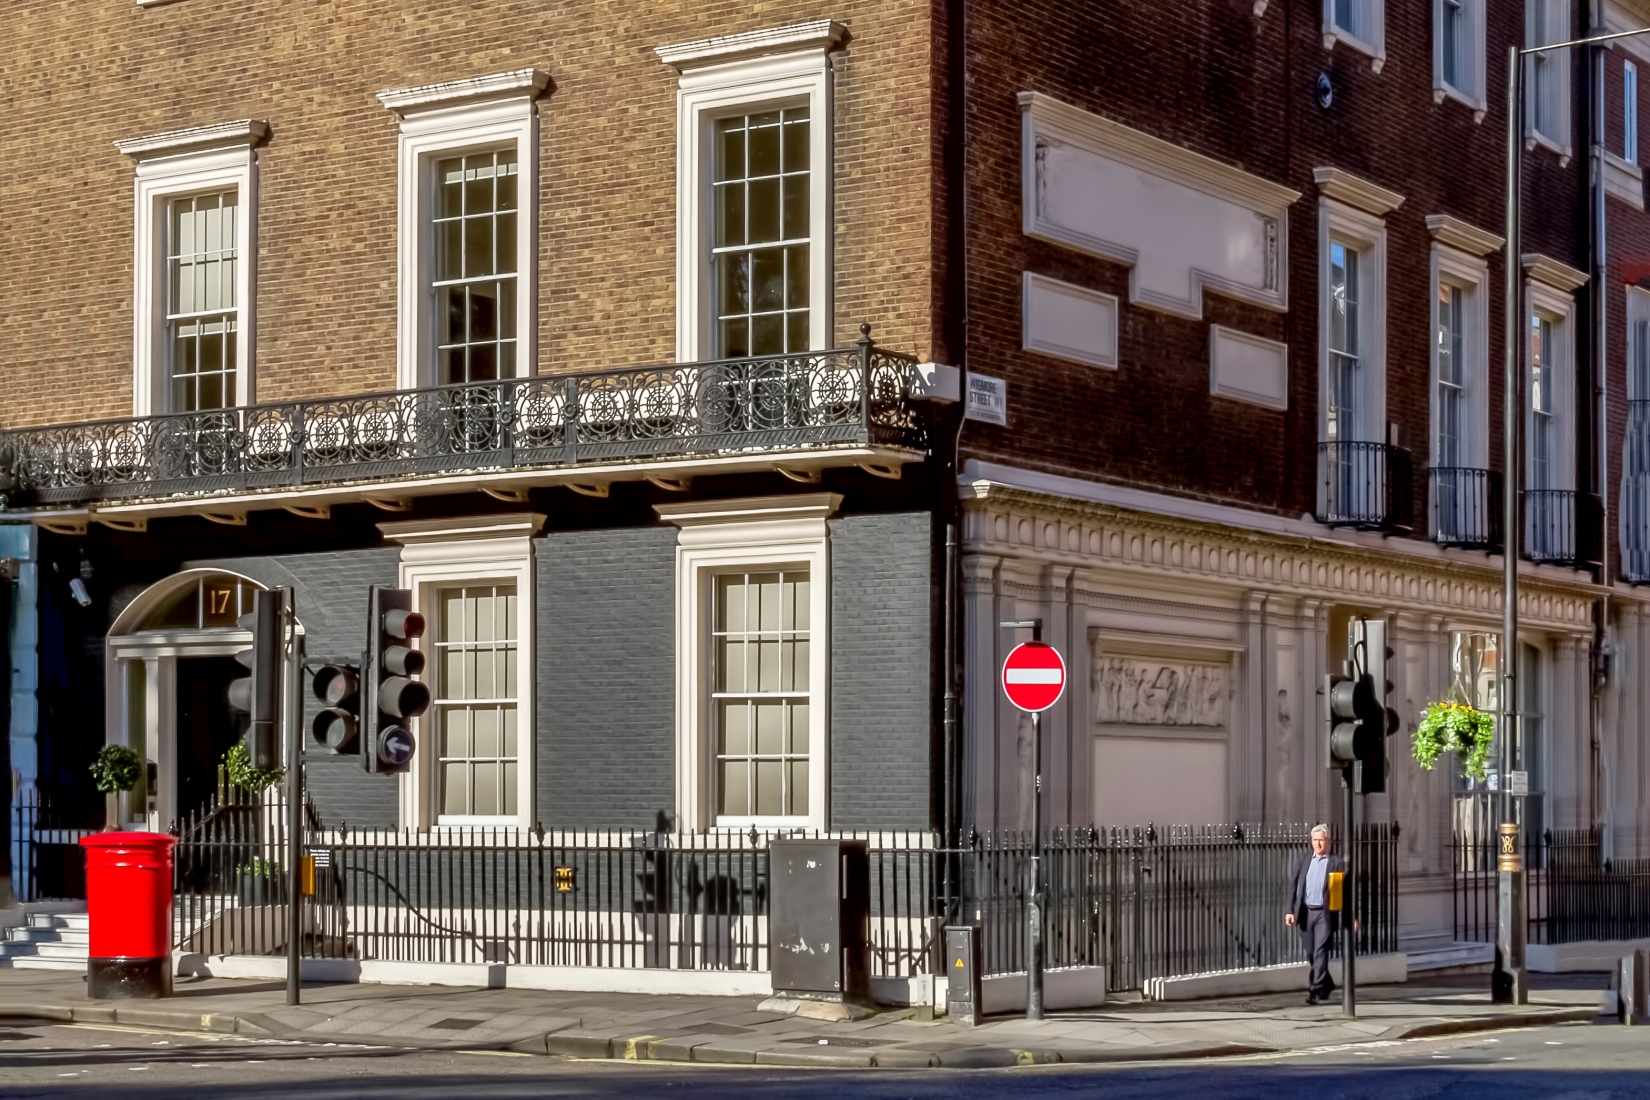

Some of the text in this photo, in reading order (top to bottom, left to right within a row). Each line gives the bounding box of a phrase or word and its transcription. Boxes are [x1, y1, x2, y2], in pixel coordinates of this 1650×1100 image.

[970, 377, 997, 394] WIGMORE
[969, 391, 991, 406] STREET
[211, 589, 231, 614] 17
